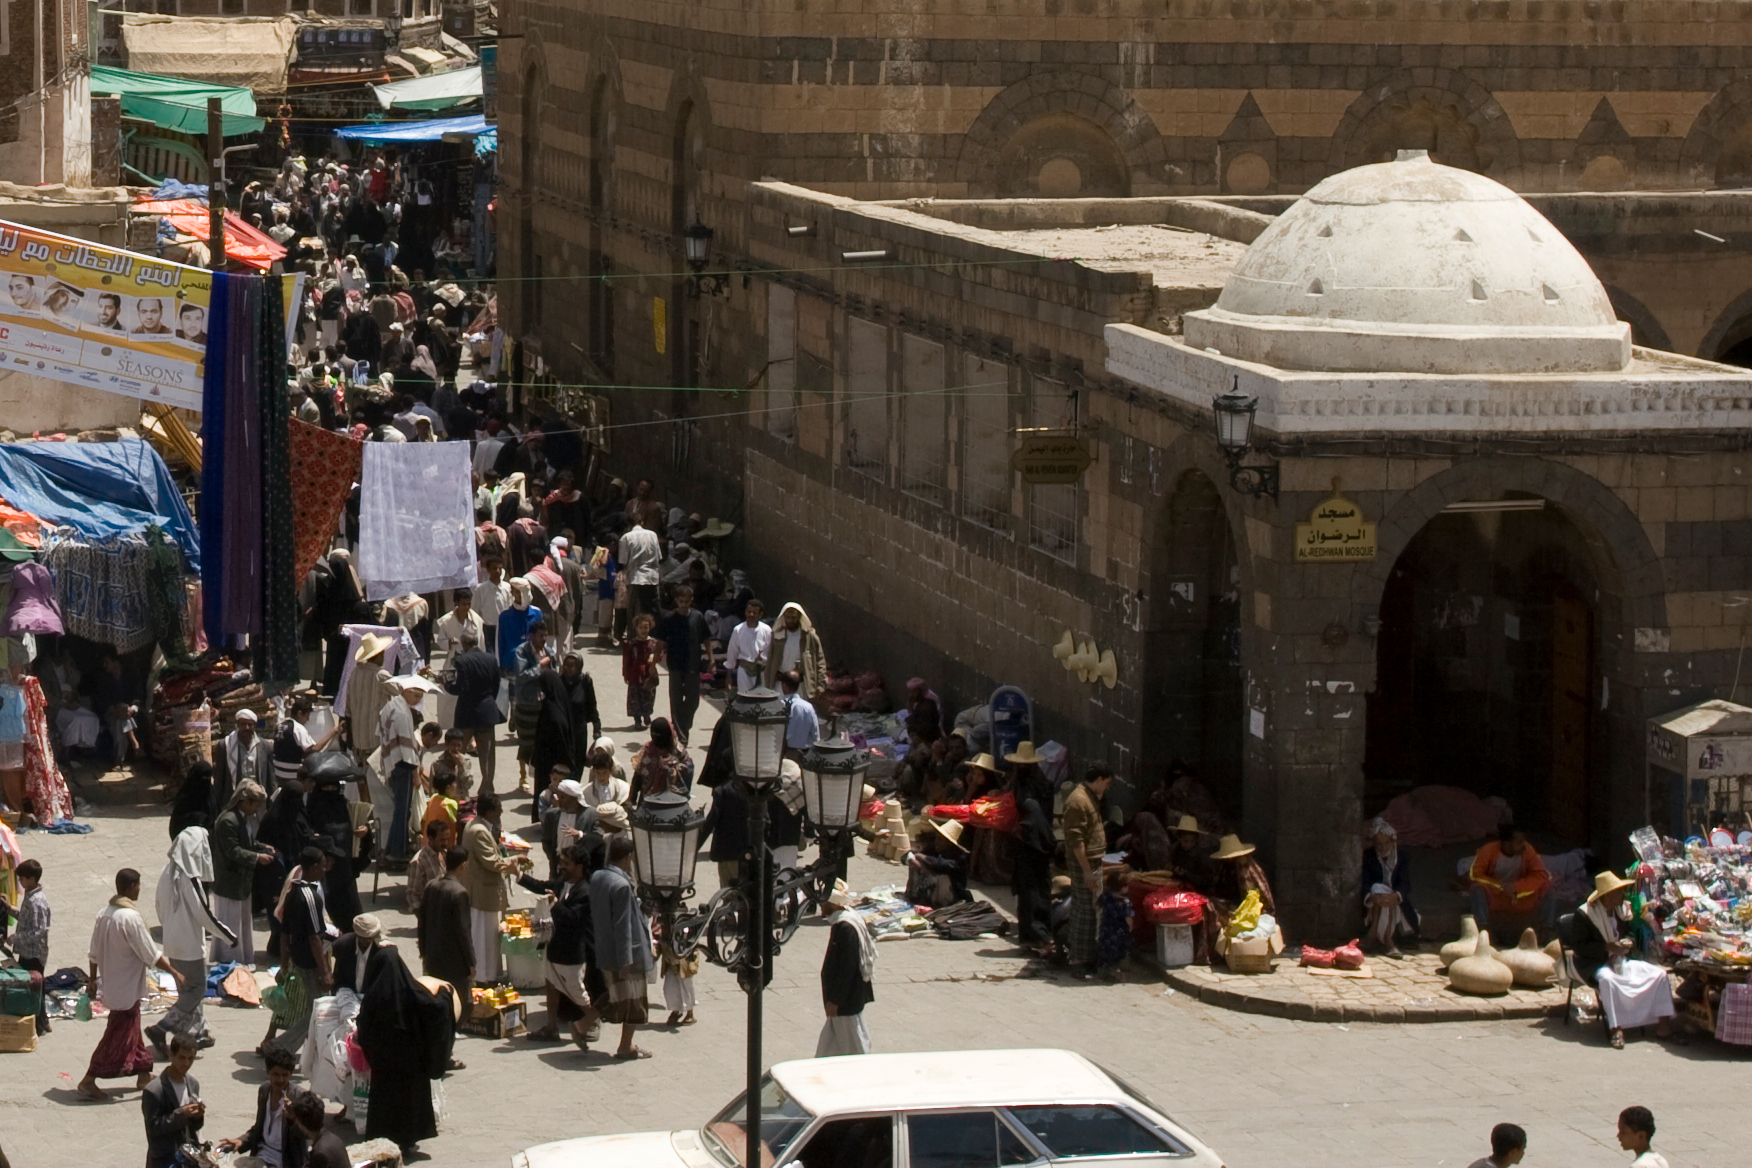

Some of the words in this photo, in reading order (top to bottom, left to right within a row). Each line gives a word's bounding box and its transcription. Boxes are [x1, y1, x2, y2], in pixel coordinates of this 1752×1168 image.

[21, 240, 49, 262] مع
[54, 243, 133, 277] اللحظات
[117, 359, 183, 384] SEASONS
[1318, 507, 1355, 522] مسجد
[1307, 528, 1366, 544] الرضوان
[1299, 547, 1344, 557] AL-REDHWAN
[1344, 546, 1374, 556] MOSQUE
